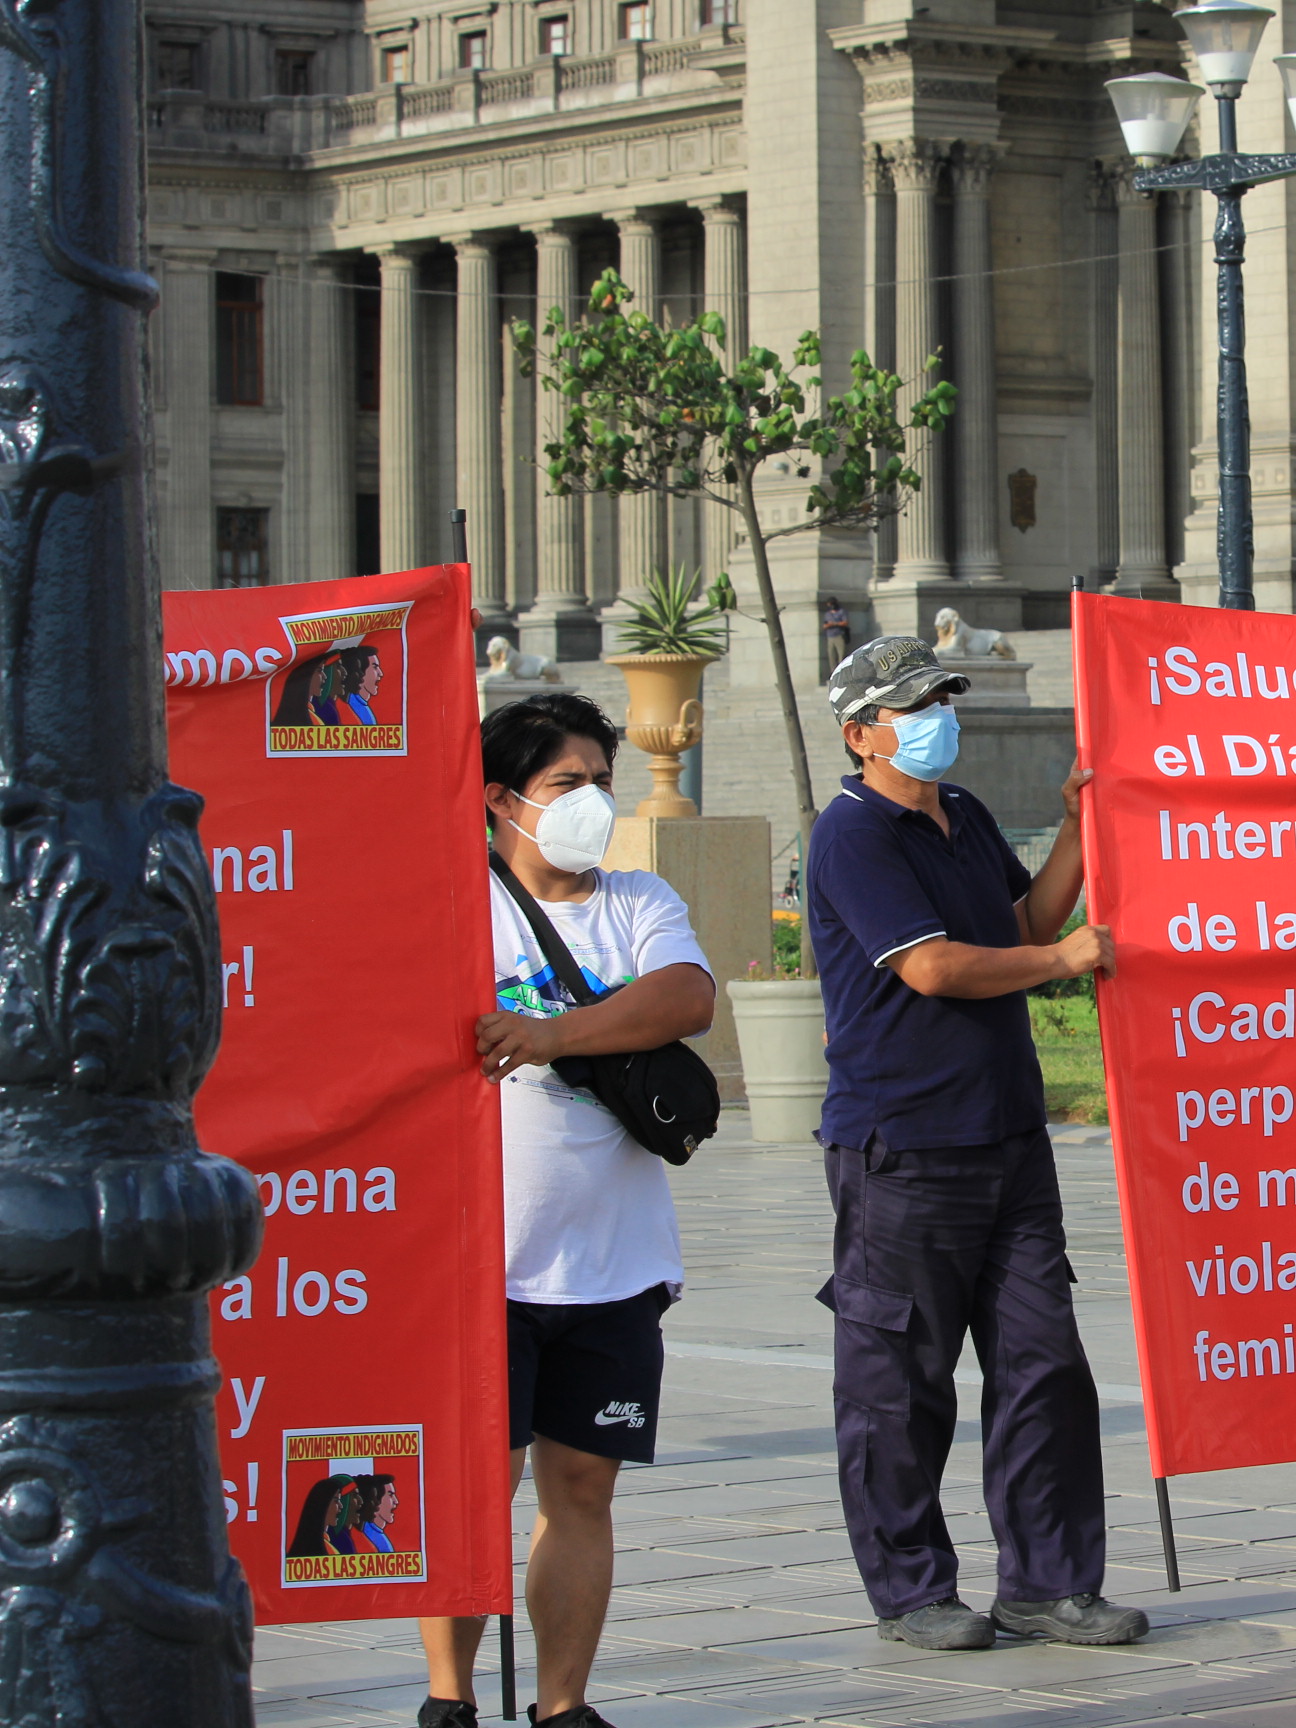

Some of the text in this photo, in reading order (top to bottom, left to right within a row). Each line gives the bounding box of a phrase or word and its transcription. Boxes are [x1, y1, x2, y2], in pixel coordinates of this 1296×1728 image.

[289, 609, 403, 643] MOVIMIENTO INDIGNADOS
[164, 647, 284, 687] mos
[271, 727, 401, 750] TODAS LAS SANGRES
[1154, 735, 1205, 776] el
[1167, 902, 1237, 952] de
[1181, 1161, 1240, 1213] de
[220, 1257, 368, 1322] a los
[230, 1376, 266, 1439] y
[604, 1401, 641, 1416] NIKE
[627, 1417, 645, 1428] SB
[288, 1432, 418, 1460] MOVIMIENTO INDIGNADOS
[286, 1552, 421, 1580] TODAS LAS SANGRES
